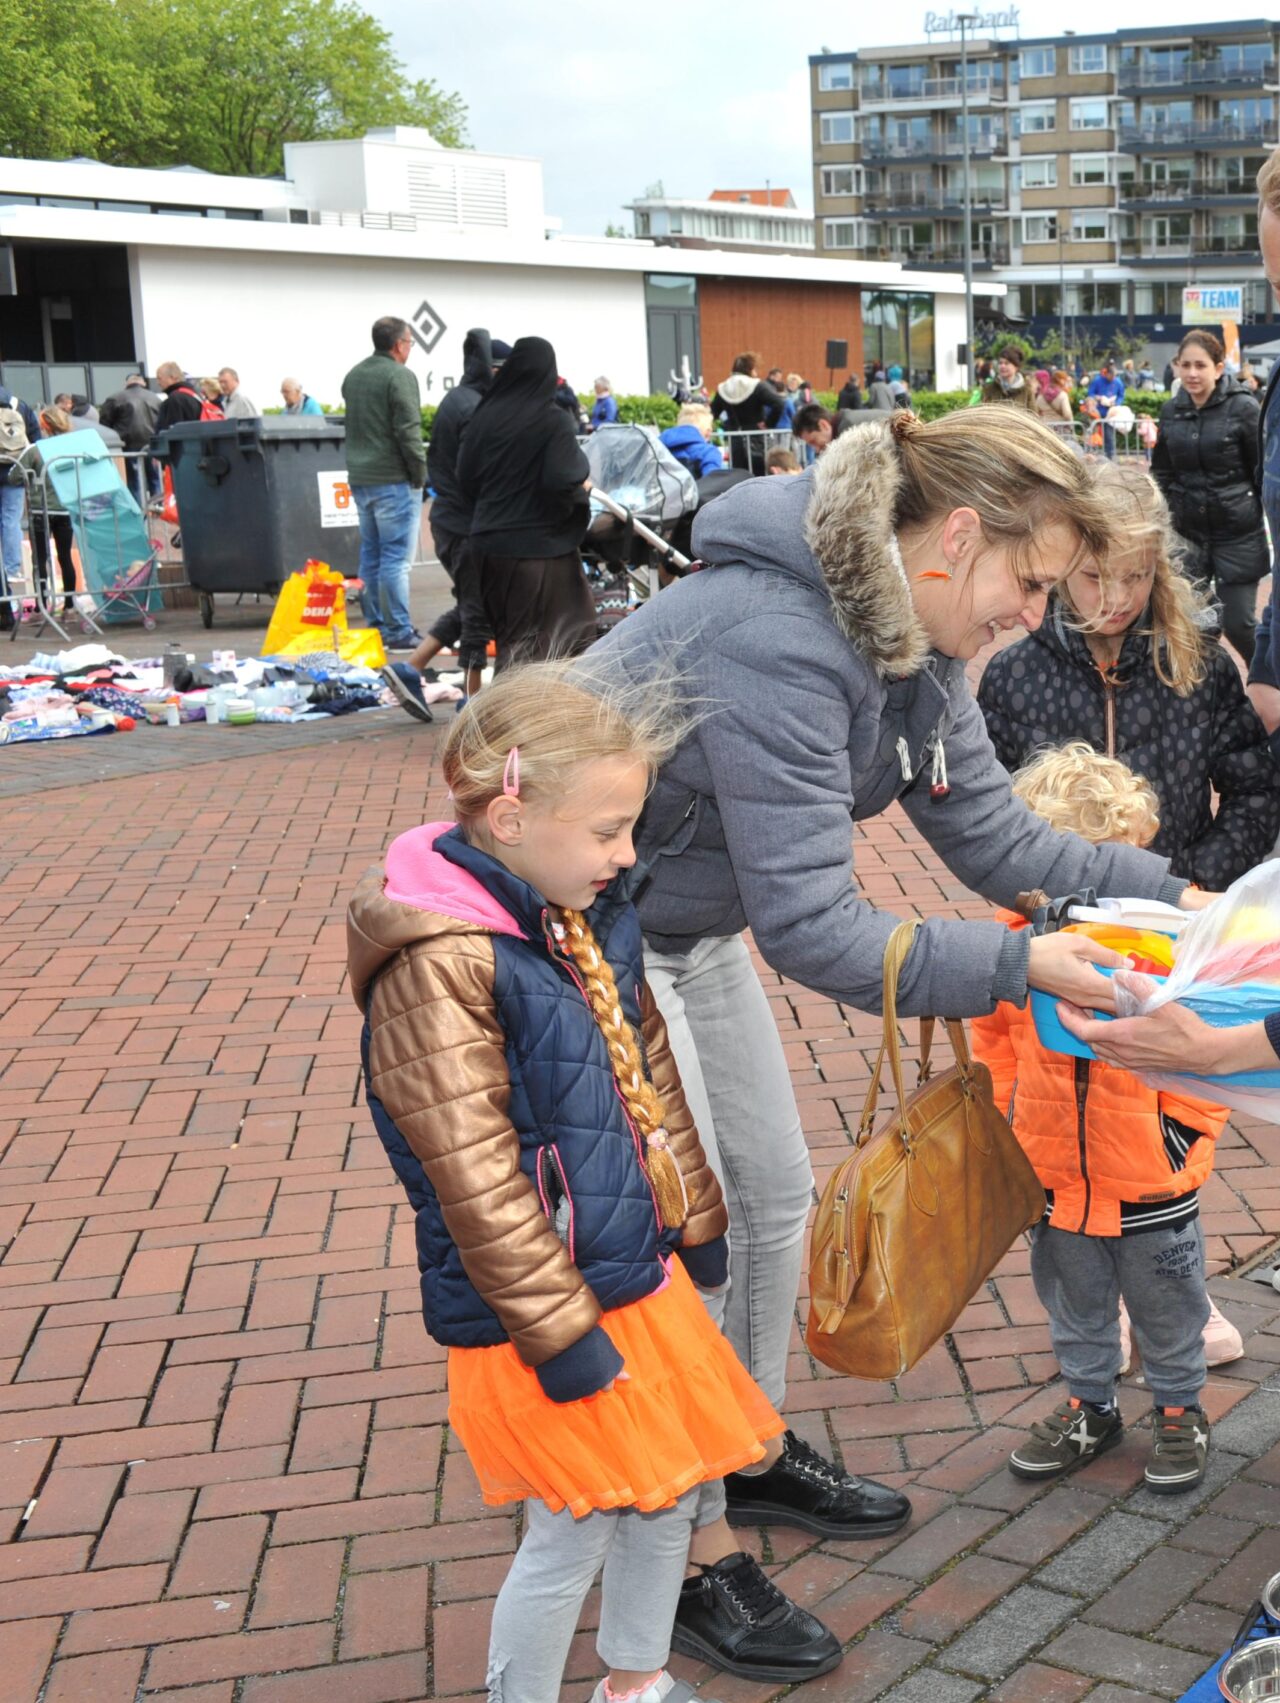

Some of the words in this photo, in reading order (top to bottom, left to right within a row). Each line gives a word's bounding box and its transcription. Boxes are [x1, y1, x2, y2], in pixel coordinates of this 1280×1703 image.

[1201, 291, 1239, 309] TEAM
[303, 606, 334, 618] DEKA
[1153, 1241, 1196, 1265] DENVER
